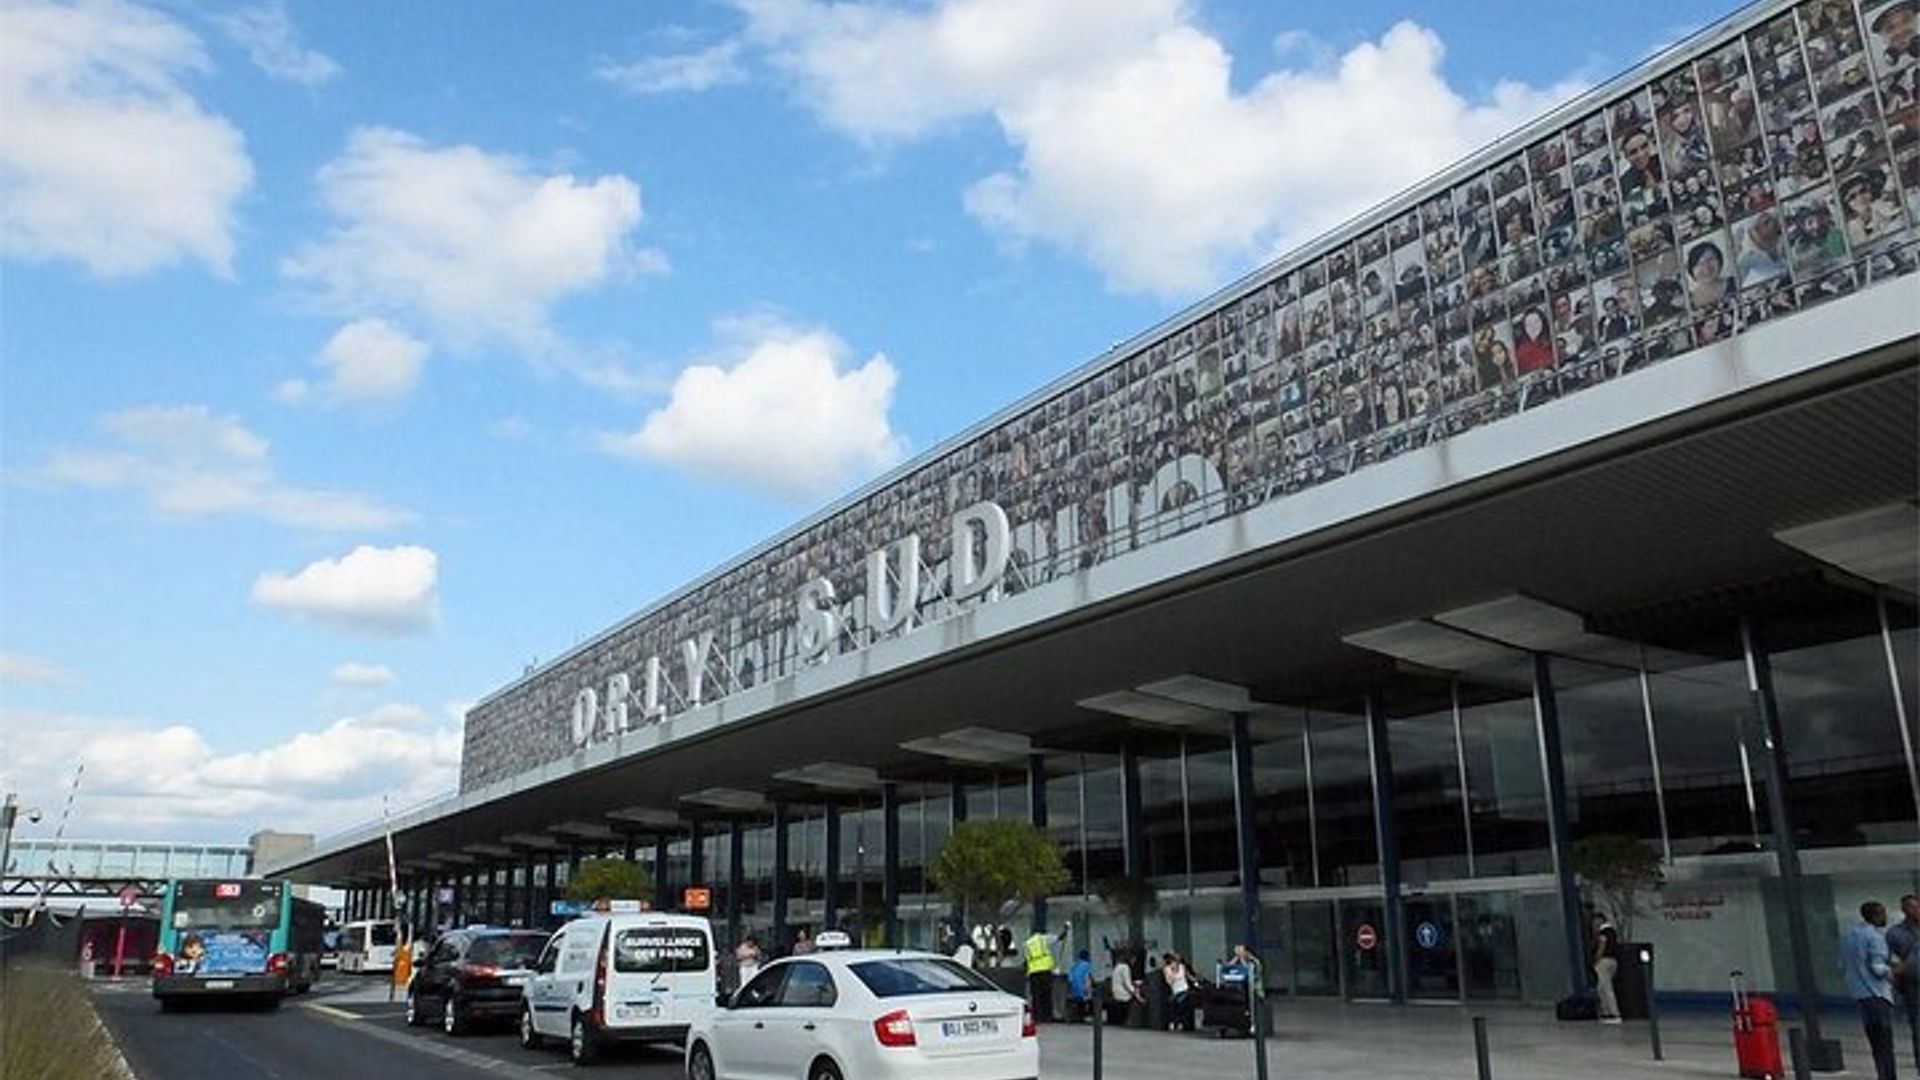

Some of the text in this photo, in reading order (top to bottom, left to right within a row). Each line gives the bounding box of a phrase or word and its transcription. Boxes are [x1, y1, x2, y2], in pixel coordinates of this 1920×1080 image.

[572, 630, 714, 745] ORLY
[798, 500, 1011, 660] SUD
[626, 937, 702, 947] SURVEILLANCE
[659, 948, 695, 959] PARCS
